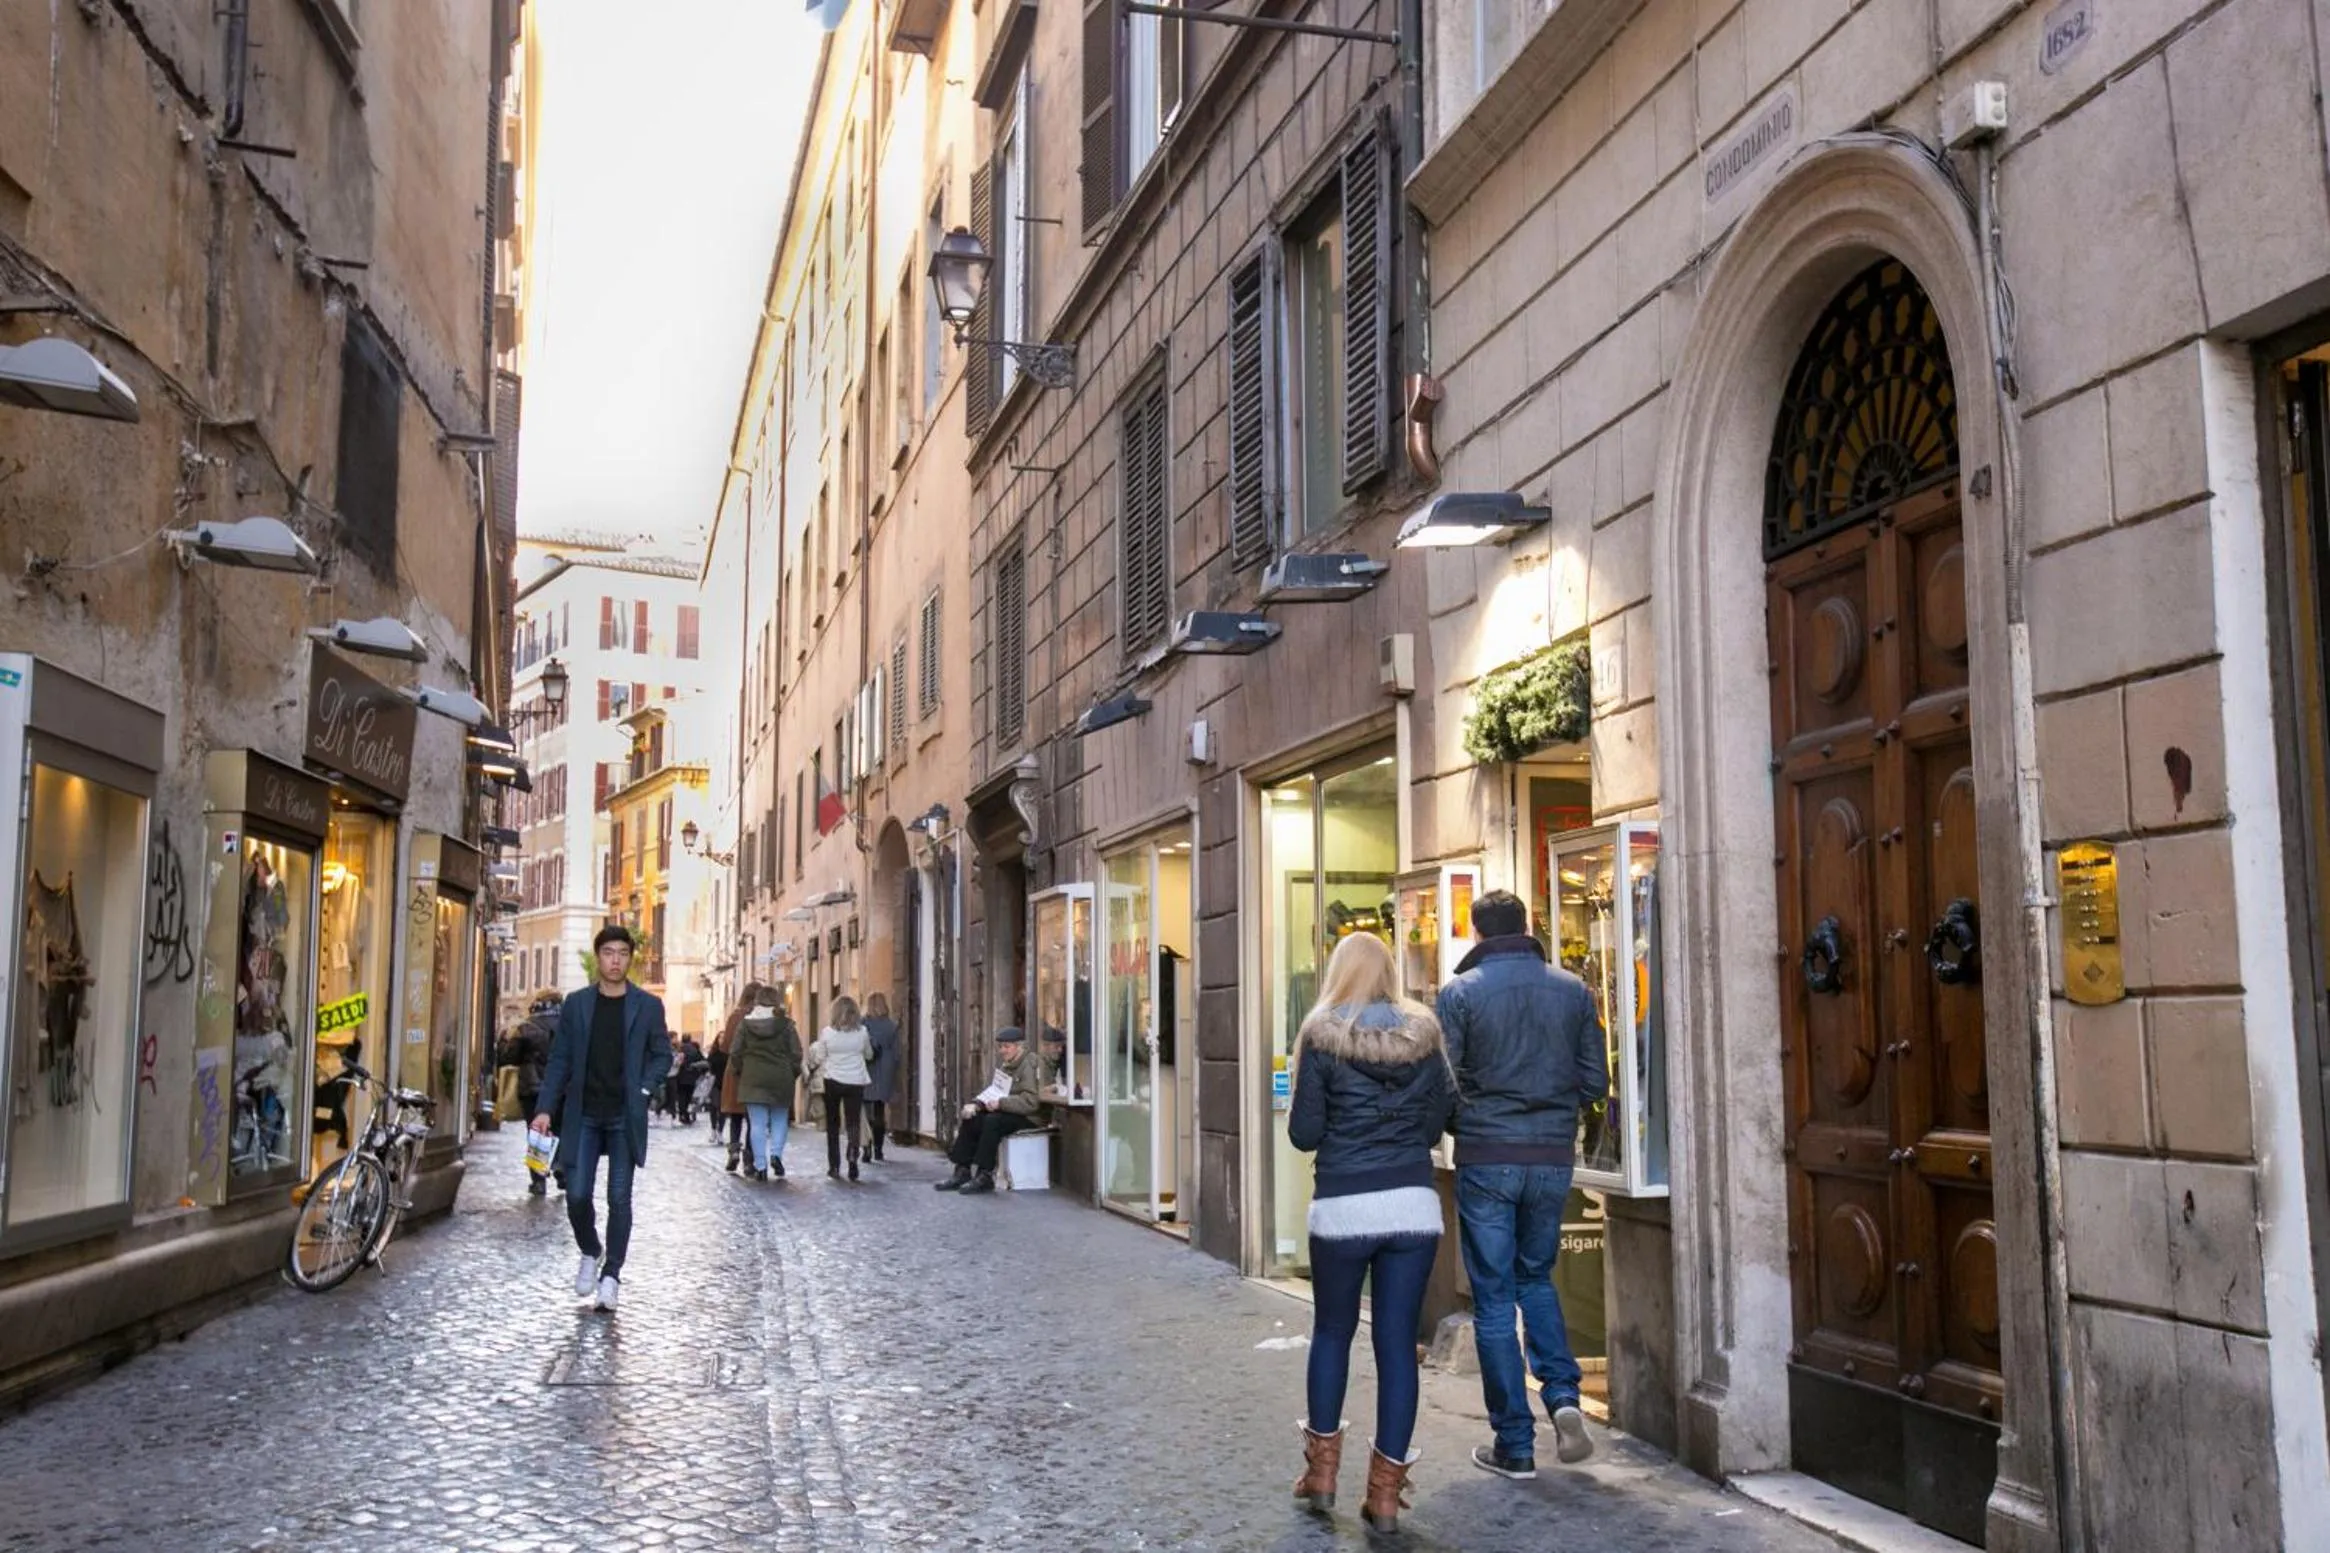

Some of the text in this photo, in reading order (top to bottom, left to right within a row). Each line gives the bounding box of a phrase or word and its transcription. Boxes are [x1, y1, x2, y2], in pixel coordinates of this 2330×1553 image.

[1706, 103, 1790, 197] CONDOMINIO
[314, 677, 404, 786] Di Castro
[317, 998, 368, 1032] SALDI
